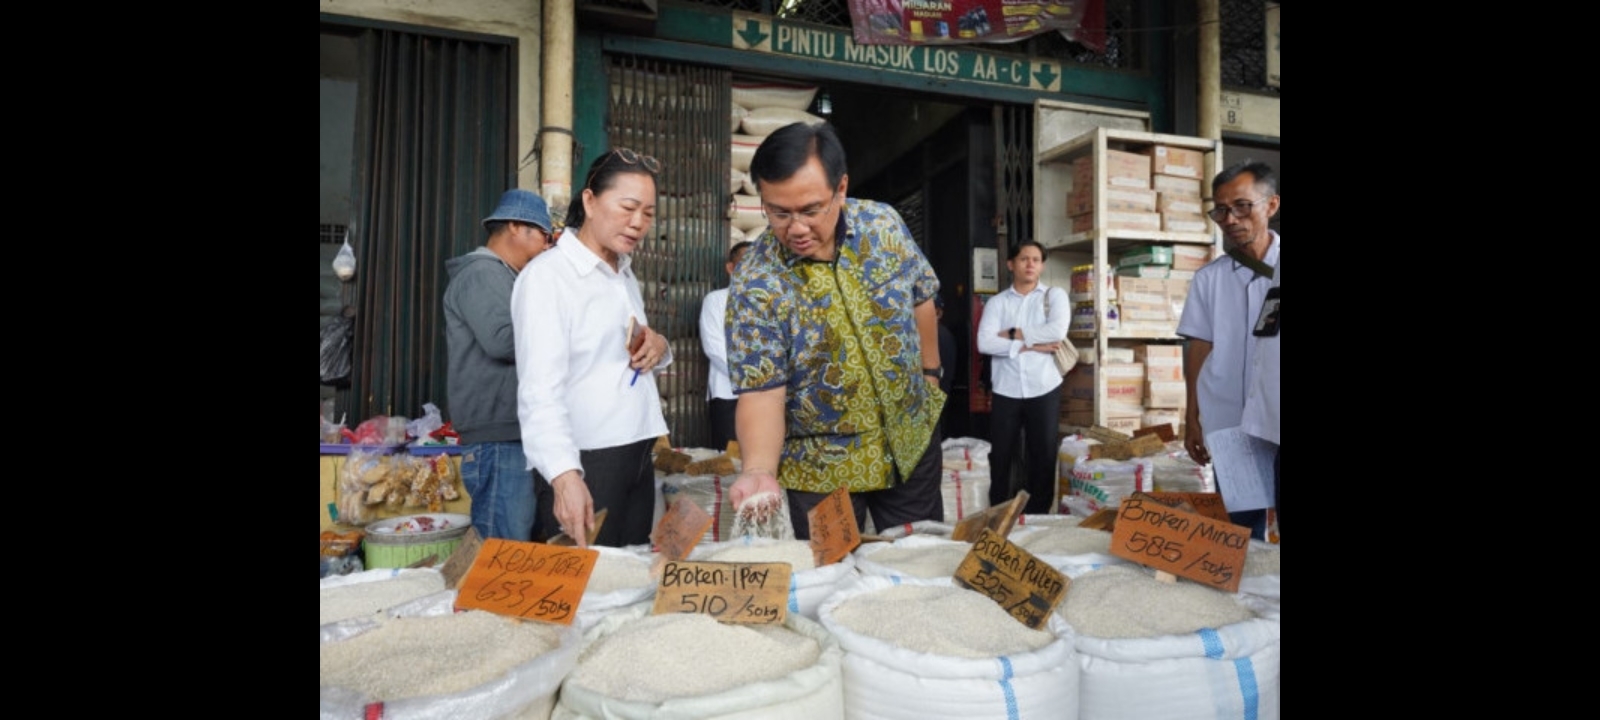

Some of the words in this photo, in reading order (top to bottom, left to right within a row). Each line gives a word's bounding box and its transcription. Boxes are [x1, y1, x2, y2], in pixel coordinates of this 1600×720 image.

[778, 26, 834, 59] PINTU
[845, 36, 915, 70] MASUK
[923, 50, 959, 75] LOS
[1125, 531, 1185, 563] 585
[475, 572, 534, 608] 653
[969, 569, 1014, 604] 525
[680, 593, 728, 616] 510
